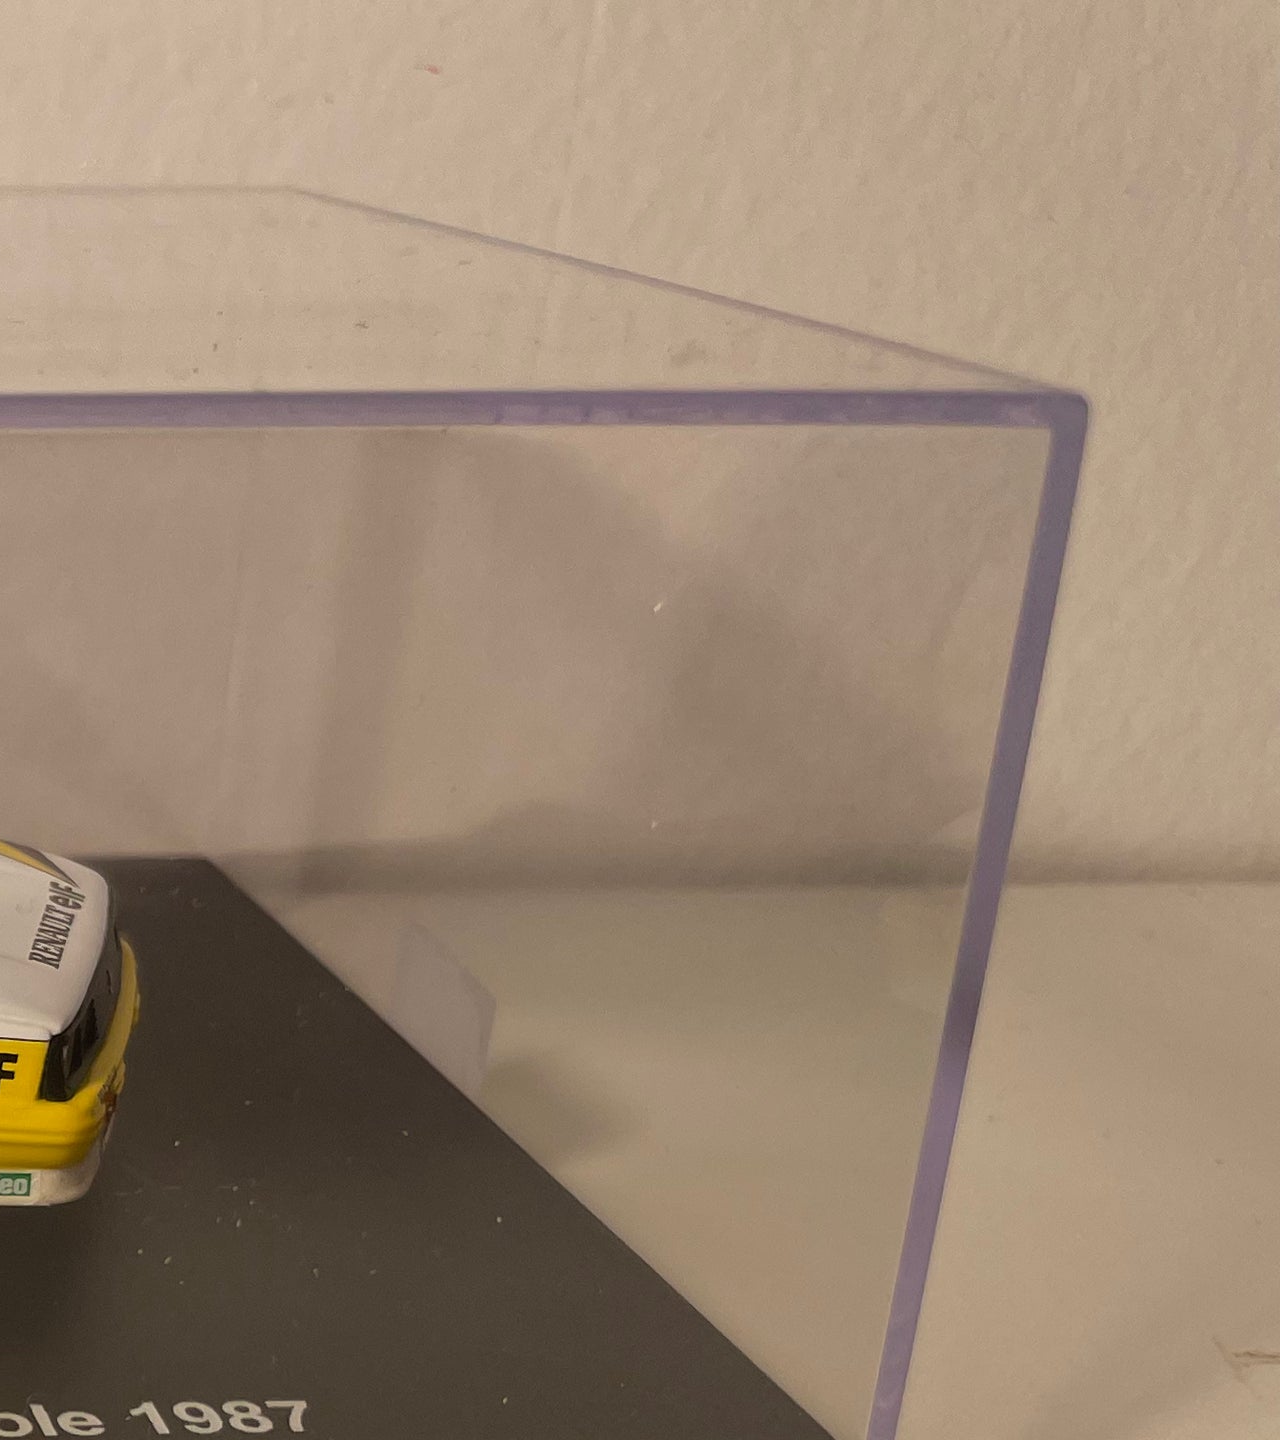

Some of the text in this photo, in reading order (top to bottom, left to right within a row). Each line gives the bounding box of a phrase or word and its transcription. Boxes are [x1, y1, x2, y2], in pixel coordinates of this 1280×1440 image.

[28, 881, 86, 969] RENAULT elf
[129, 1400, 308, 1435] 1987
